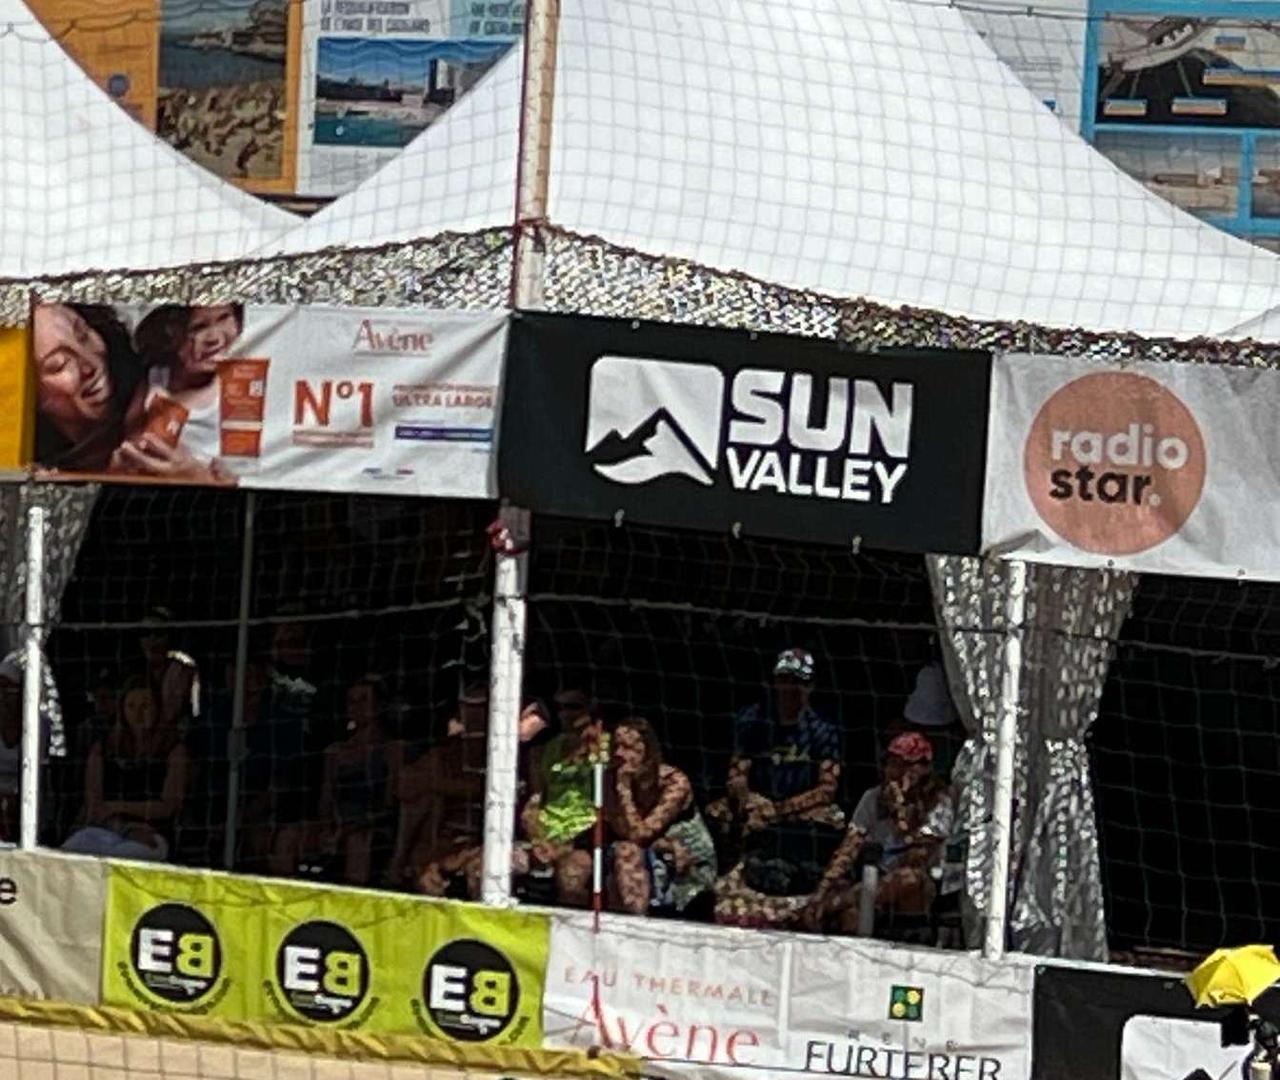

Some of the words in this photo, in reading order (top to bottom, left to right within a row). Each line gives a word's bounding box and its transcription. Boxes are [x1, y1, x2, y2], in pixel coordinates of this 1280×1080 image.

[728, 366, 915, 459] SUN
[725, 446, 909, 505] VALLEY
[1051, 422, 1189, 472] radio
